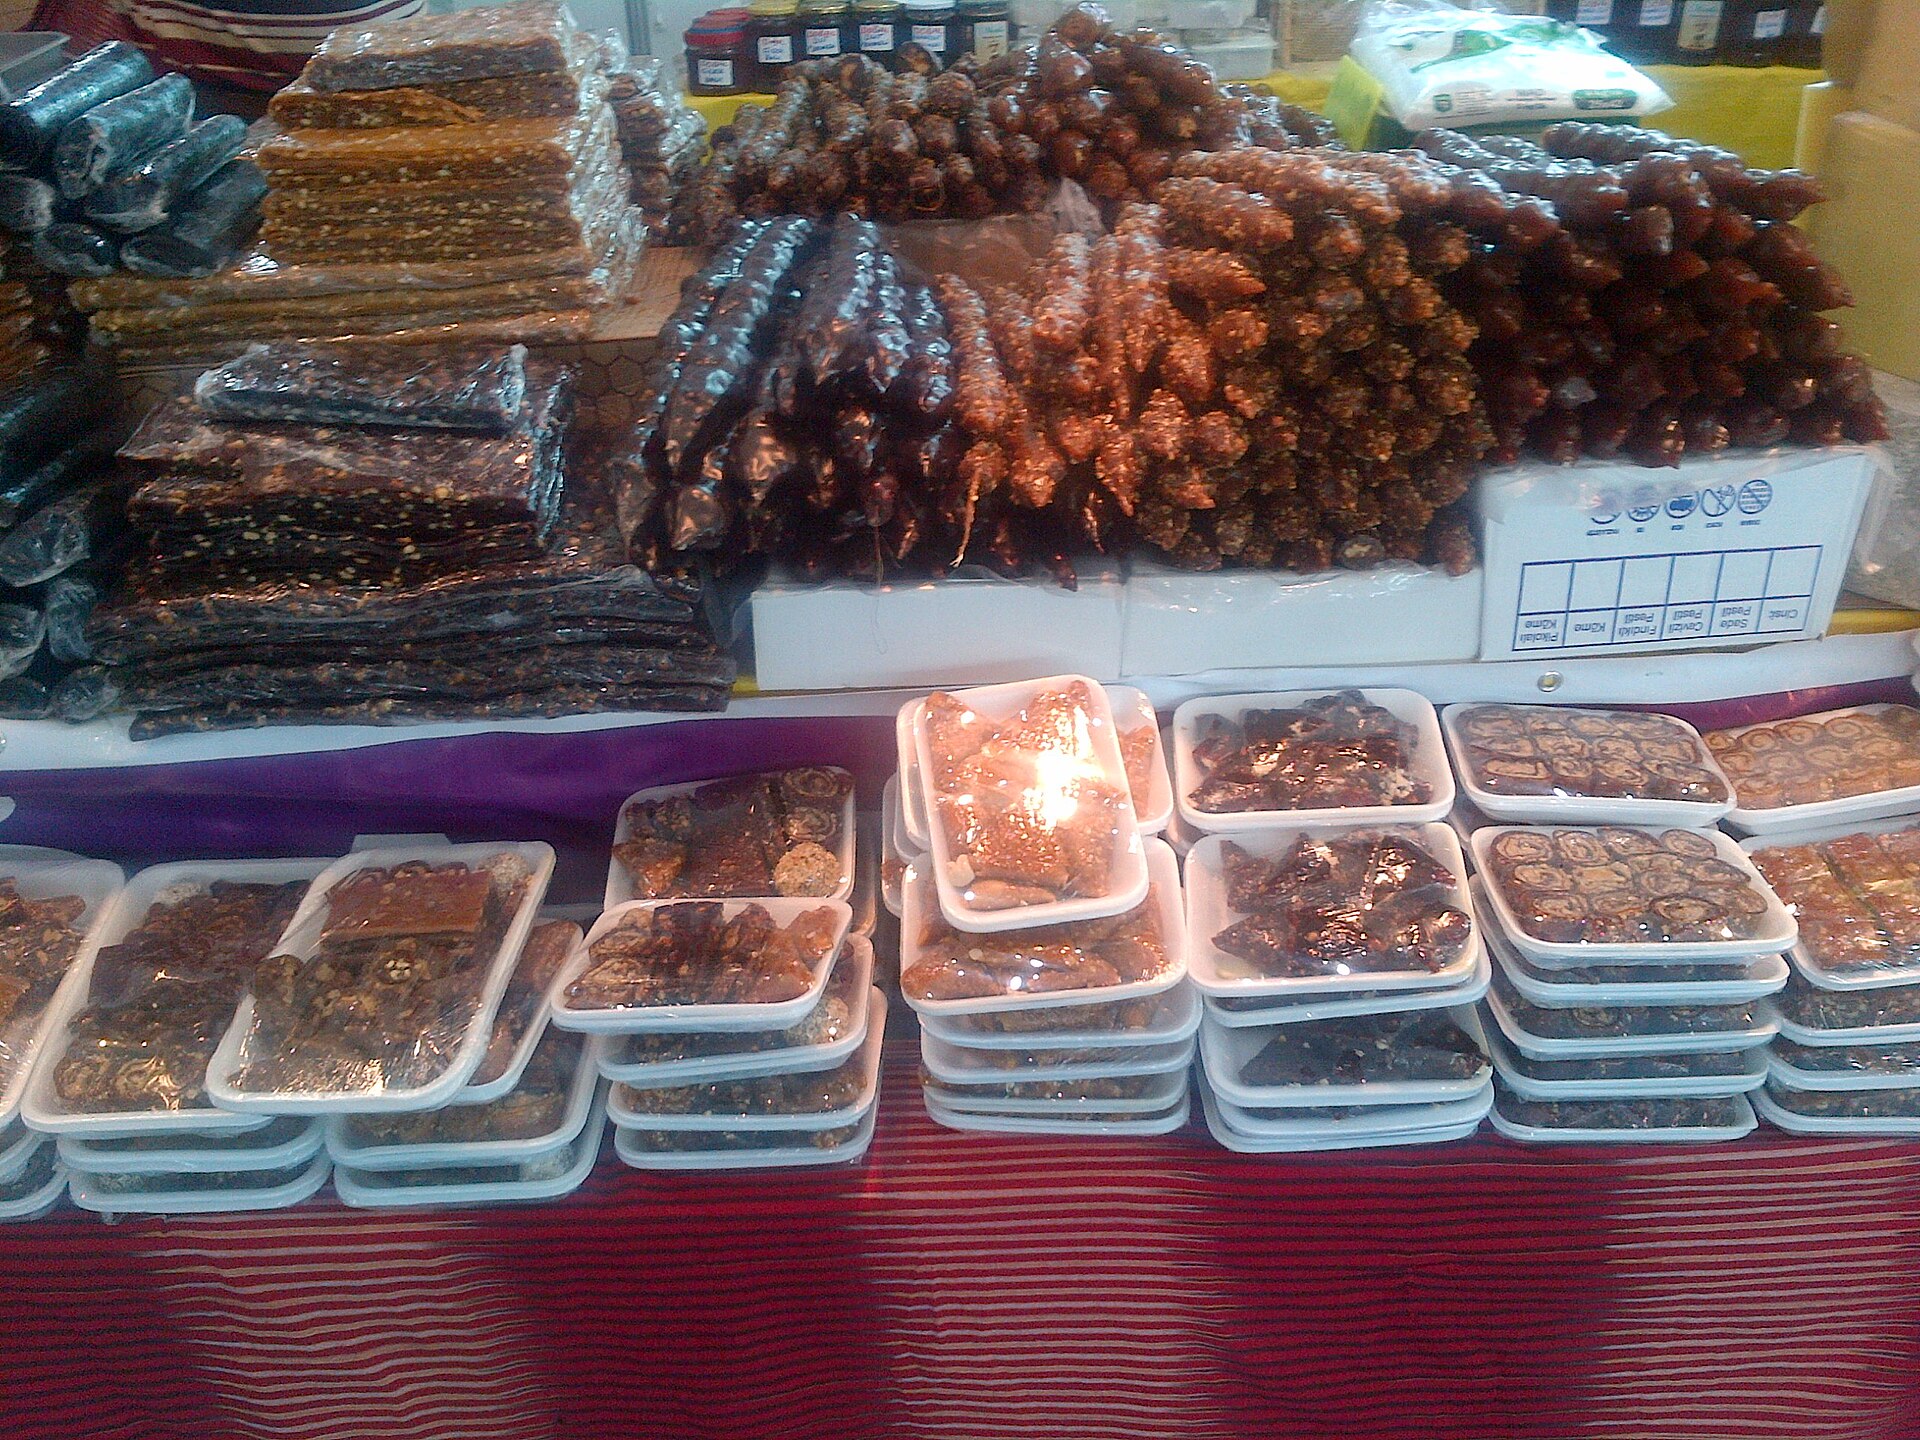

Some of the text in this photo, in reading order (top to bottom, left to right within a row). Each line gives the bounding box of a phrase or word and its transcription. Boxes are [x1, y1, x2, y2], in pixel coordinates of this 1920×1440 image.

[1673, 609, 1702, 620] Pestil
[1722, 606, 1751, 617] Pestil
[1625, 613, 1654, 623] Pestil
[1721, 619, 1748, 628] Sade
[1525, 619, 1557, 630] Köme
[1574, 622, 1606, 632] Köme
[1669, 621, 1703, 633] Cevizli
